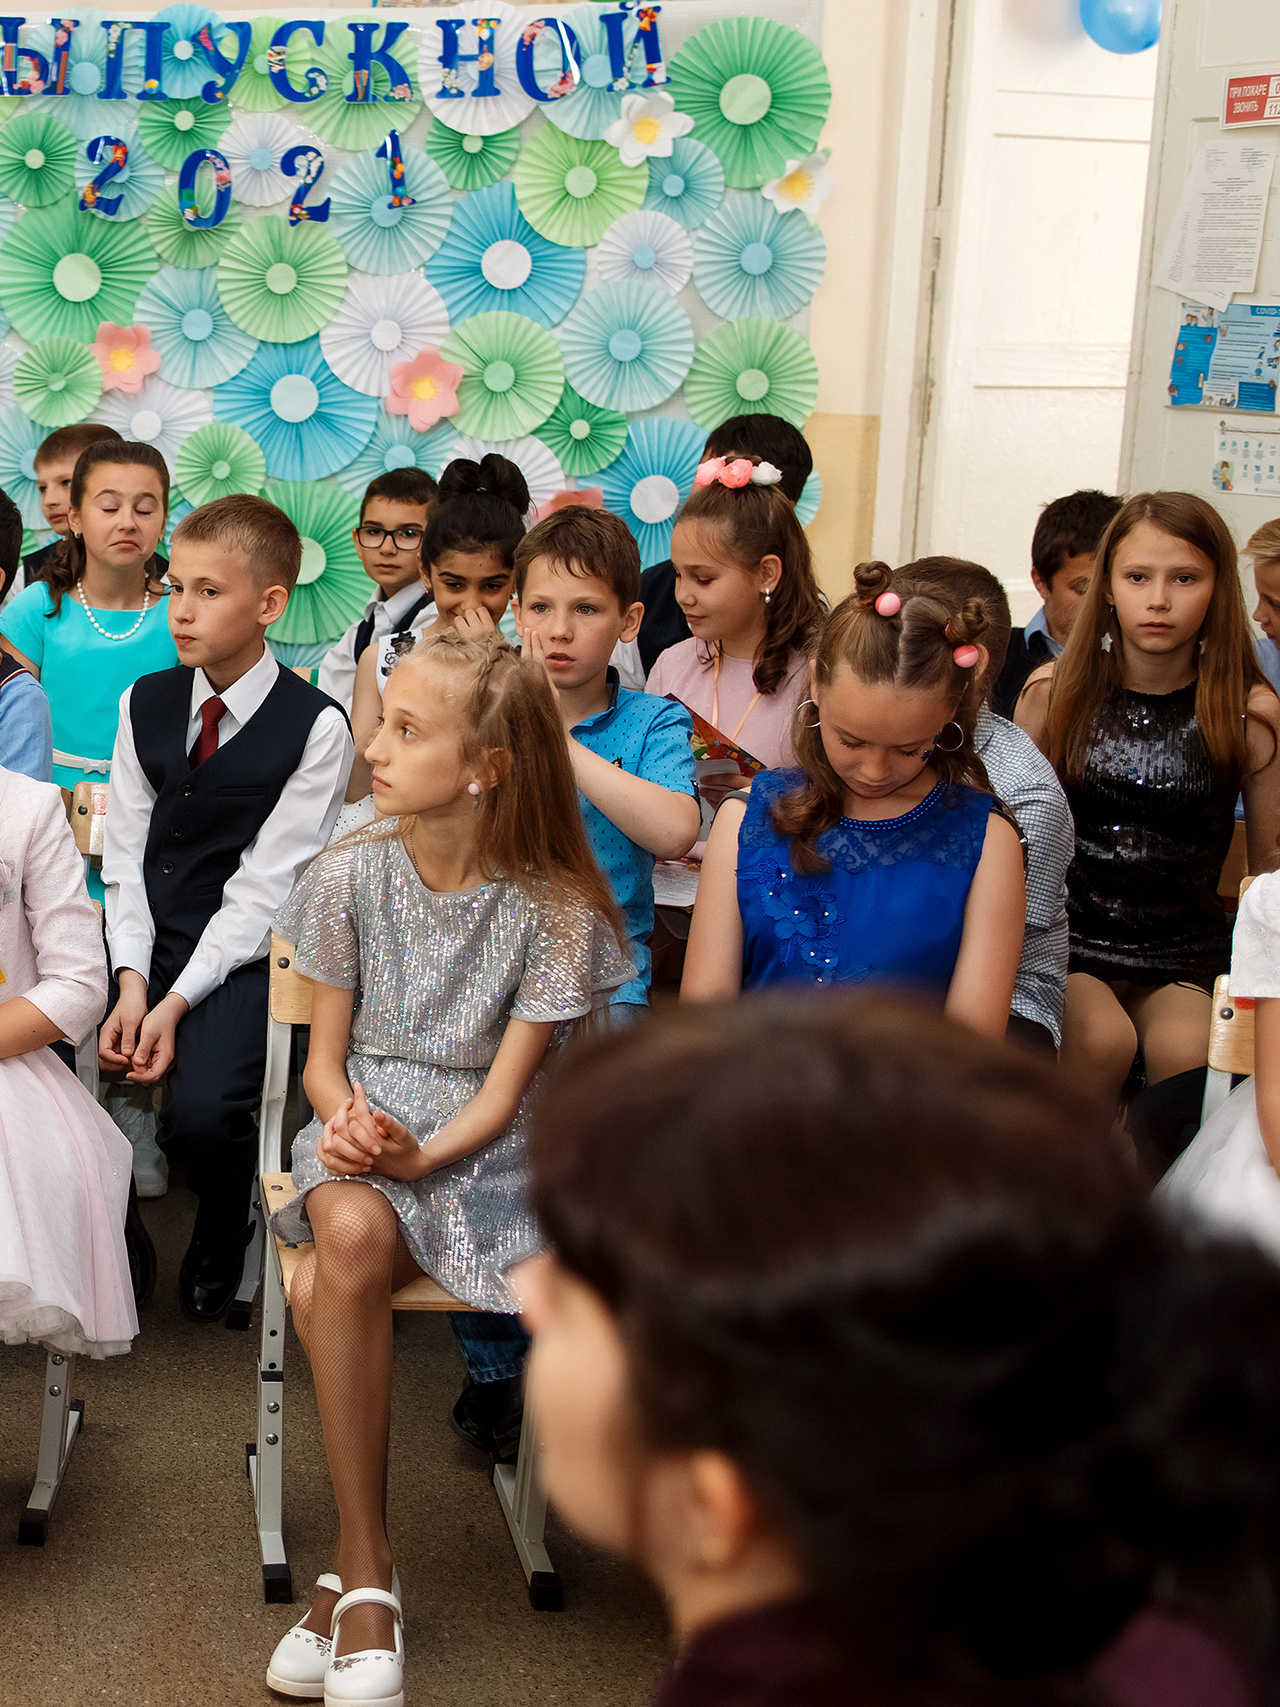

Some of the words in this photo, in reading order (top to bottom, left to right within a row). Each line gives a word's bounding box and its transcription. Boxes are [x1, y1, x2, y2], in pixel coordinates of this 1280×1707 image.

[1229, 86, 1242, 99] ПРИ
[1242, 84, 1268, 97] ПОЖАРЕ
[1233, 100, 1259, 114] ЗВОНИТЬ
[79, 129, 416, 229] 2021
[1255, 307, 1280, 316] COVID-
